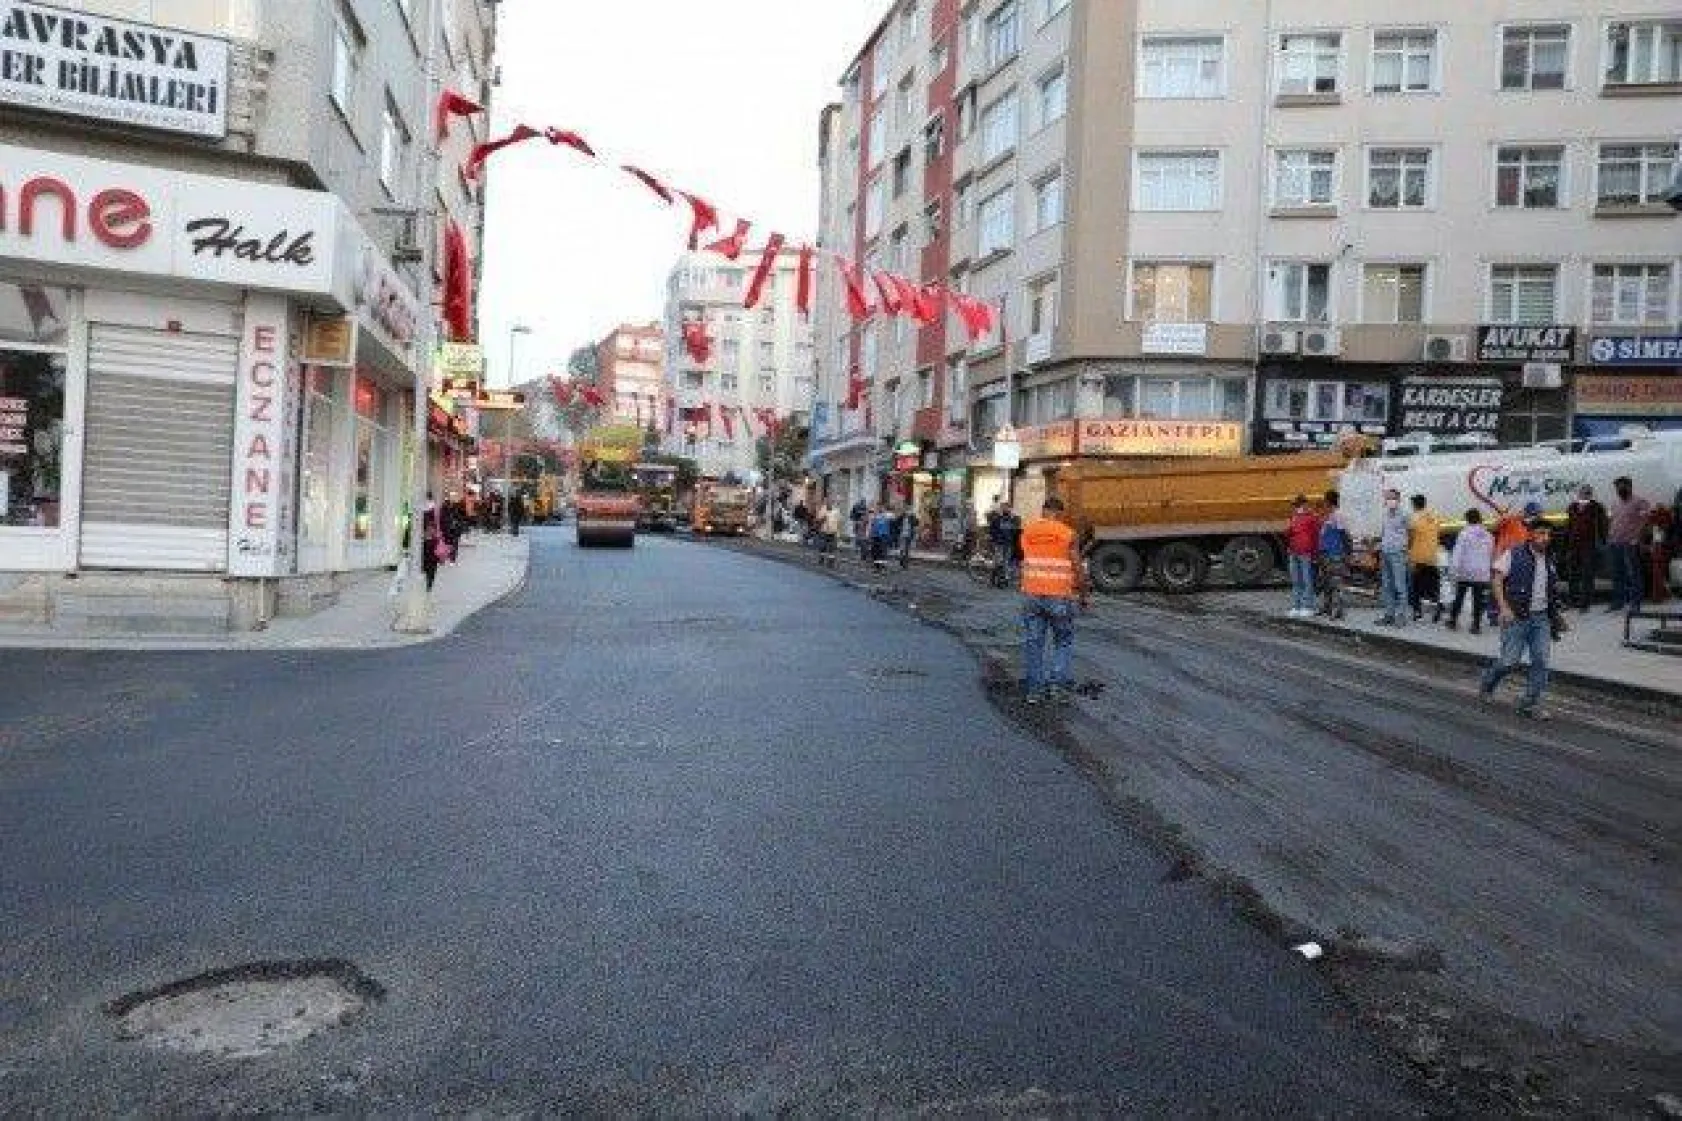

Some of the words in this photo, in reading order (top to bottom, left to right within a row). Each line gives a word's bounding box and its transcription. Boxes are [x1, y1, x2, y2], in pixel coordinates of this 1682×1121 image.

[2, 8, 198, 71] AVRASYA
[58, 57, 217, 113] BİLİMLERİ
[0, 175, 152, 249] ne
[185, 217, 315, 266] Halk
[1484, 328, 1570, 347] AVUKAT
[1402, 388, 1502, 410] KARDEŞLER
[1402, 411, 1446, 427] RENT
[1447, 412, 1460, 427] A
[1465, 412, 1499, 429] CAR
[246, 325, 276, 529] ECZANE
